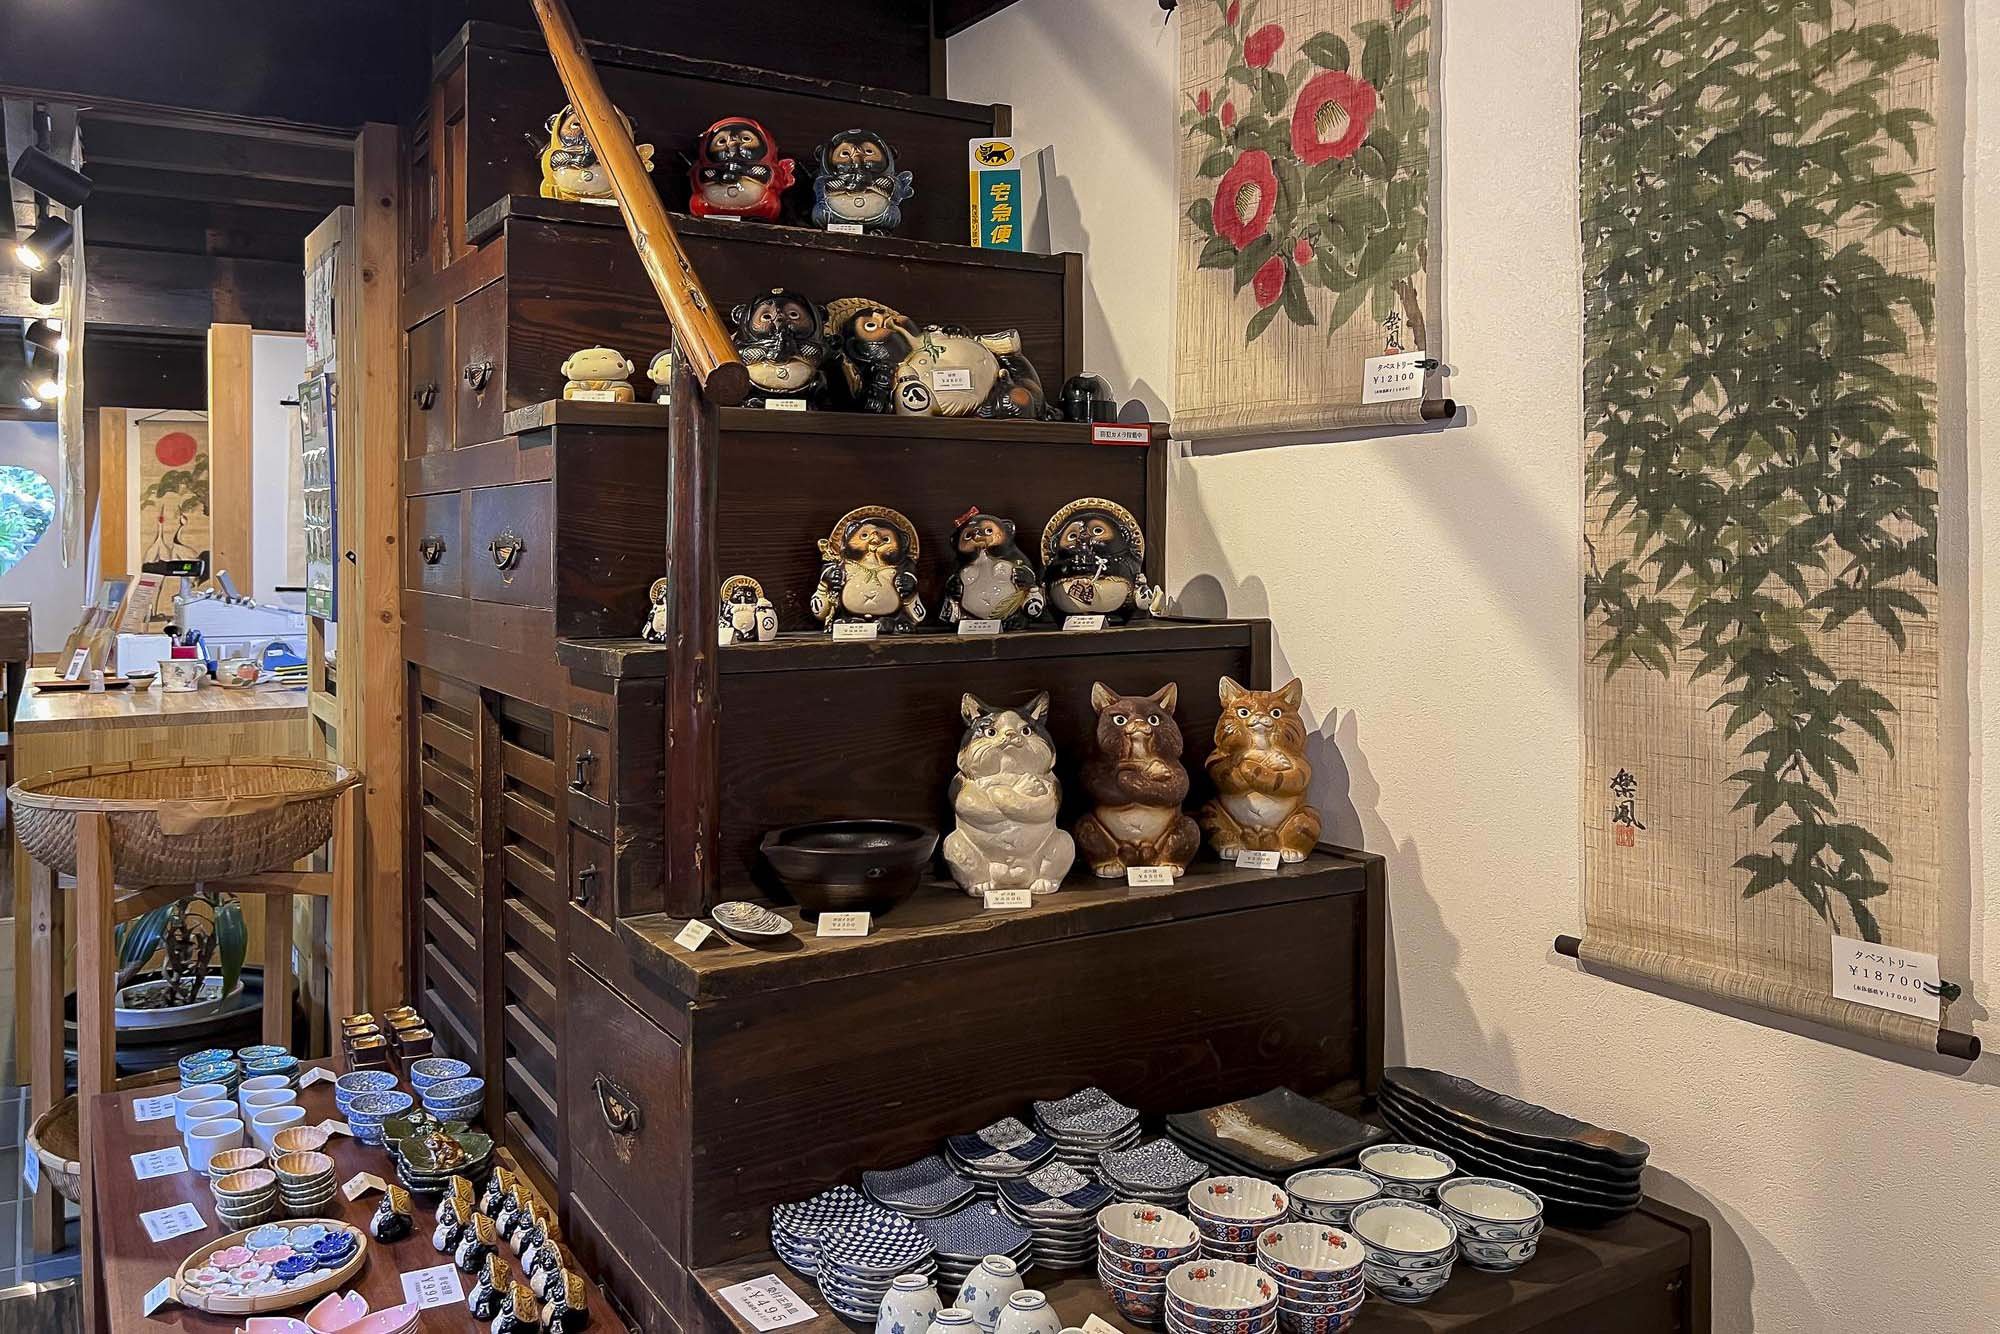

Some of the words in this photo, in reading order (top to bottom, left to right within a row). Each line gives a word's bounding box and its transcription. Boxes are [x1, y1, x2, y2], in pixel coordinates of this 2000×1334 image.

[989, 182, 1013, 244] 宅急便
[1373, 372, 1414, 385] ¥12100
[1848, 964, 1921, 990] ¥18700
[421, 1276, 439, 1303] ¥990
[748, 1290, 787, 1322] ¥495
